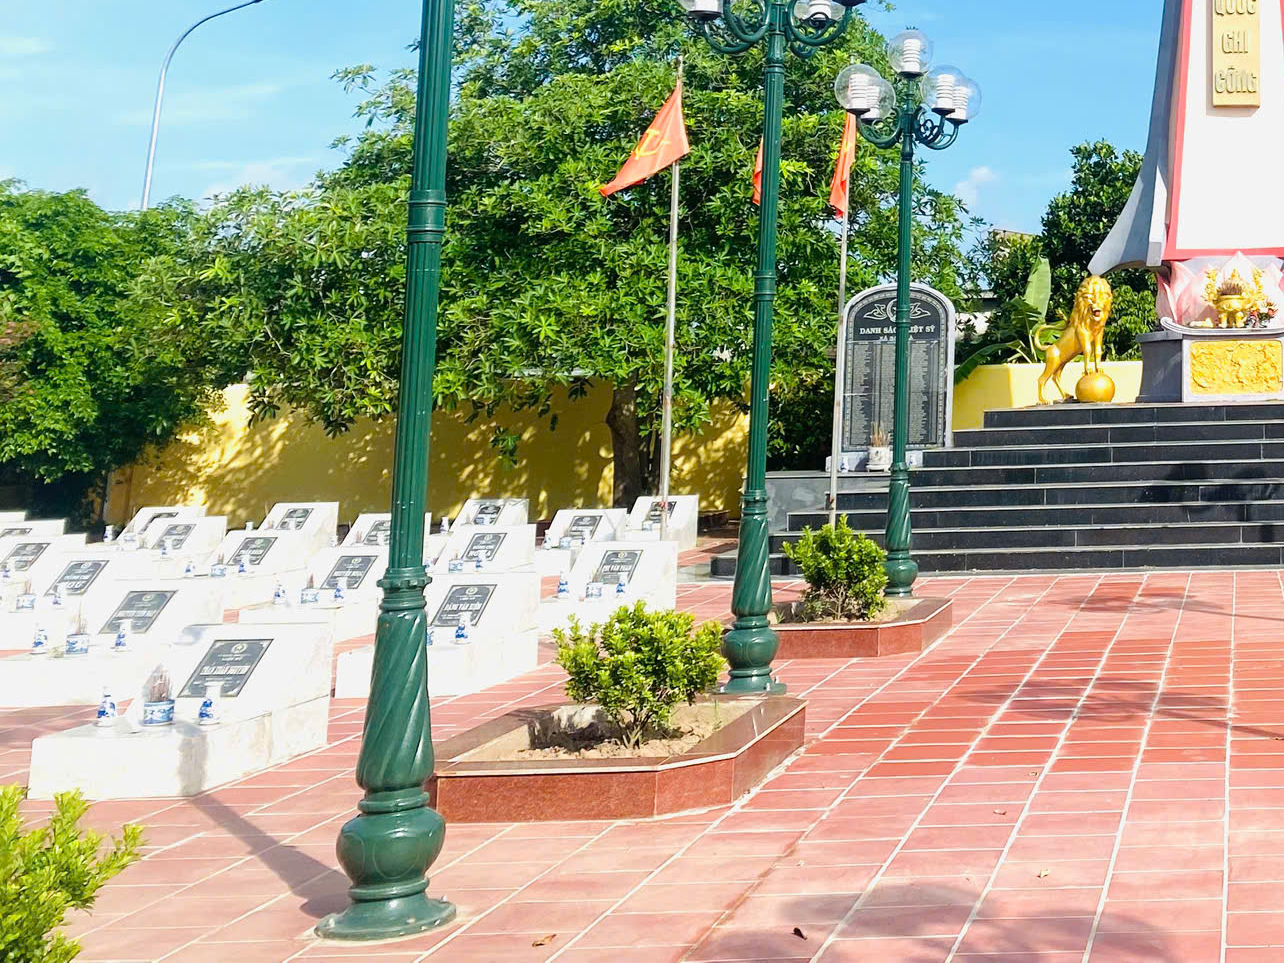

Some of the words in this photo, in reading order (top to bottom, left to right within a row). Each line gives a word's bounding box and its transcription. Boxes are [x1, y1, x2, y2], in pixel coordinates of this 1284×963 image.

[1221, 30, 1249, 54] GHI
[1214, 66, 1257, 94] CÔNG
[860, 327, 881, 335] DANH
[883, 325, 897, 334] SÁC
[908, 324, 924, 334] IỆT
